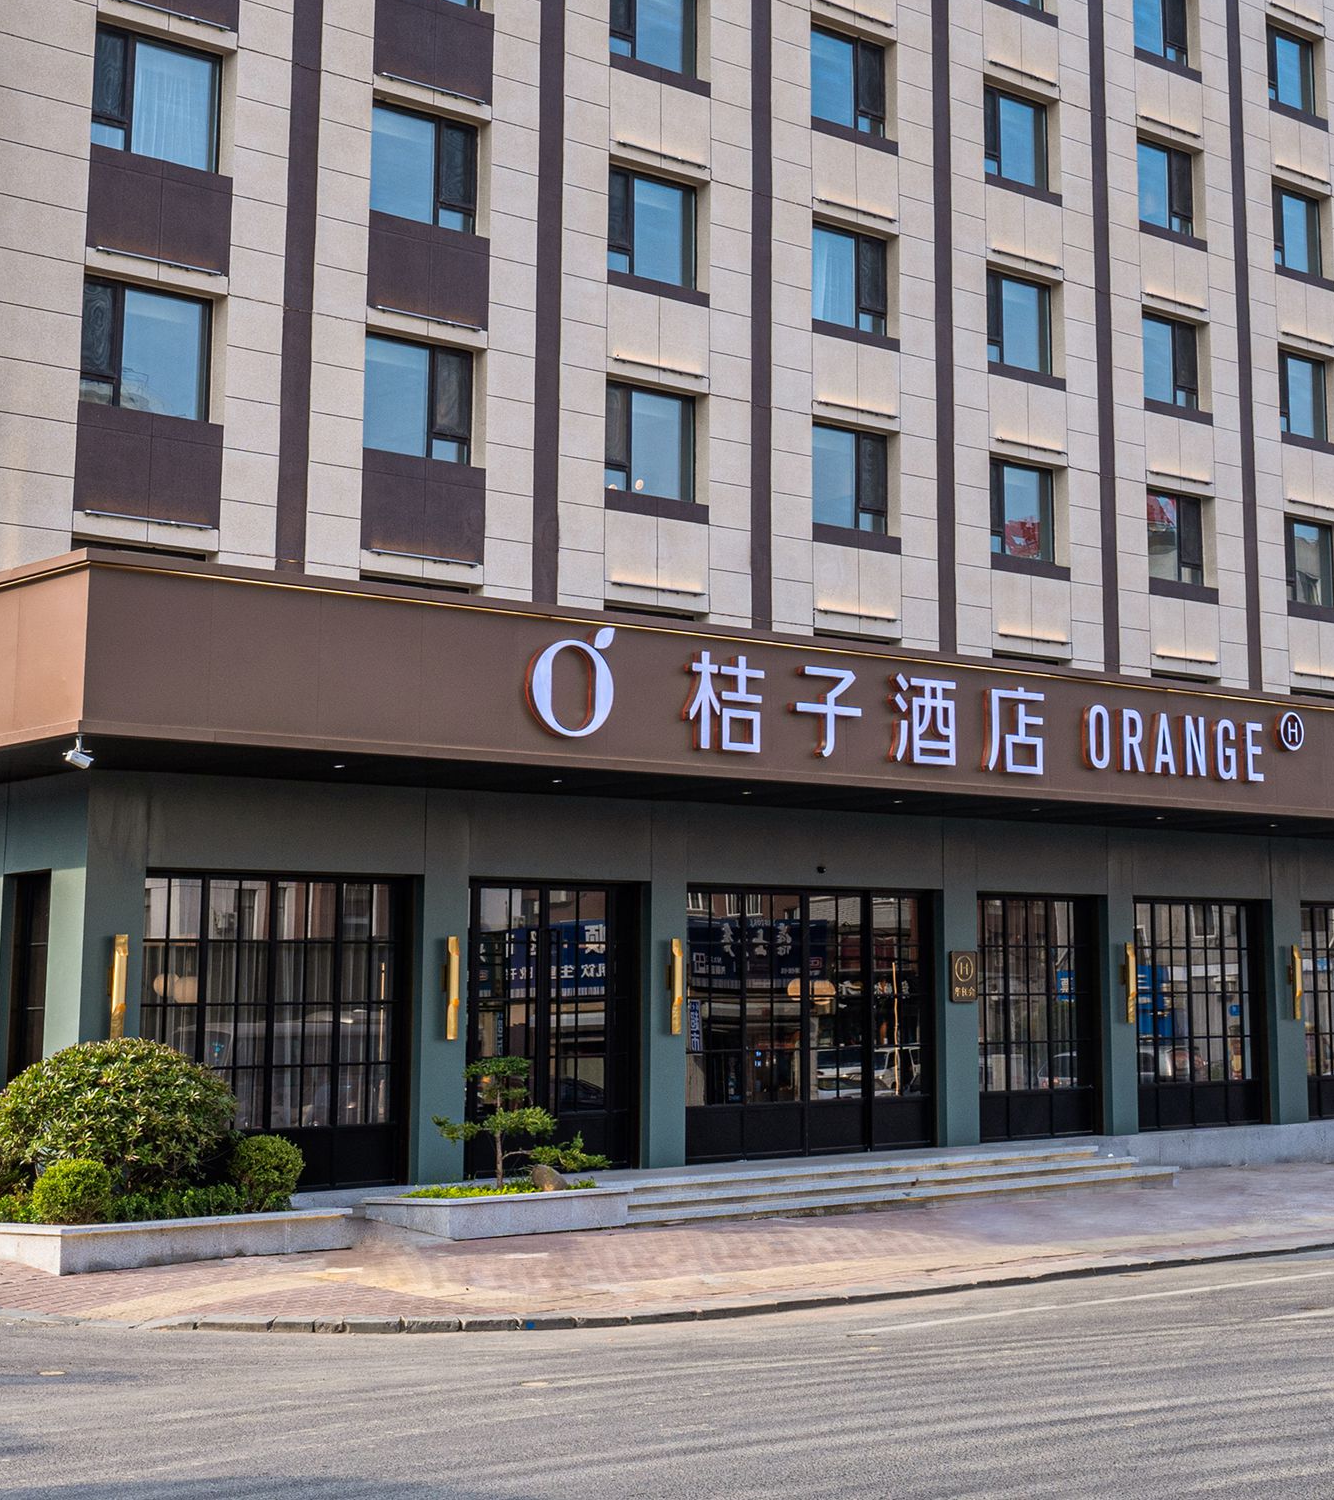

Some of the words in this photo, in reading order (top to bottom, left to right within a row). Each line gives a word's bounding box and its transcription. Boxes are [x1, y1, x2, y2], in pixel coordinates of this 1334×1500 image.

[688, 650, 1045, 775] 桔子酒店
[1088, 704, 1264, 783] ORANGE
